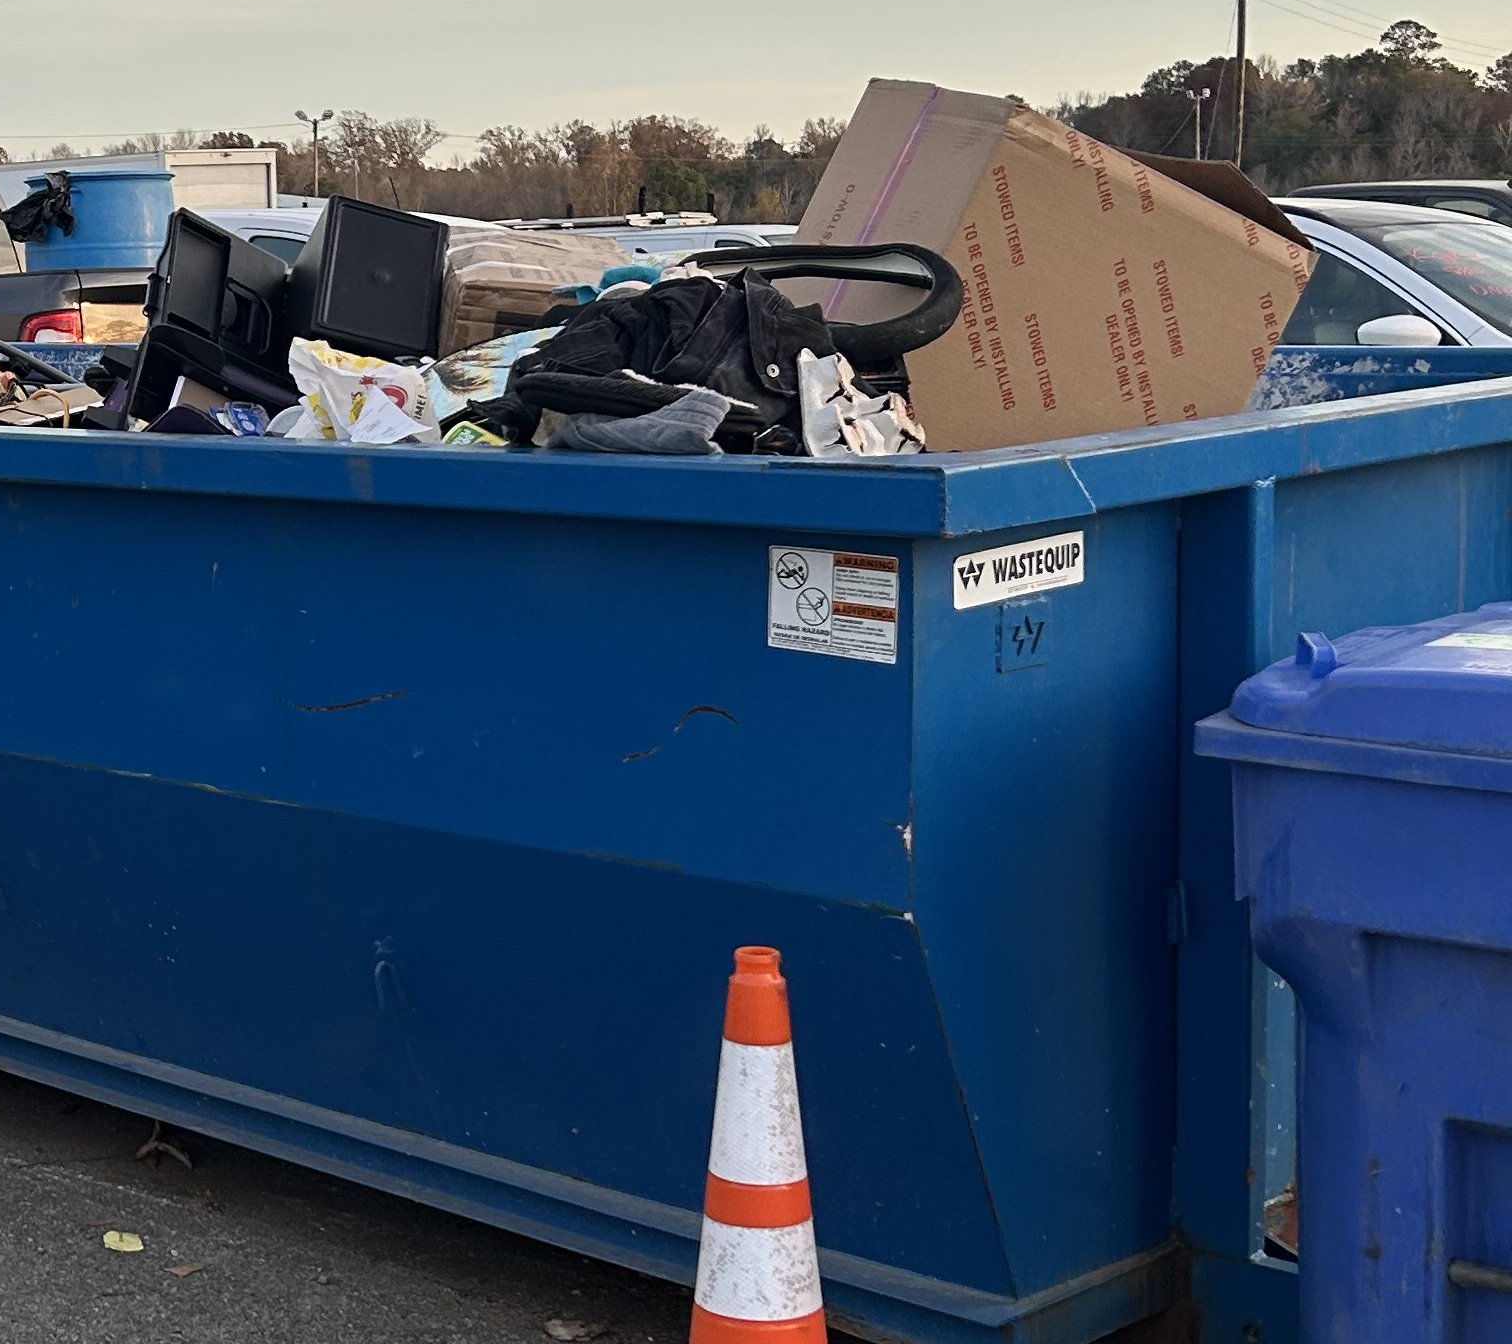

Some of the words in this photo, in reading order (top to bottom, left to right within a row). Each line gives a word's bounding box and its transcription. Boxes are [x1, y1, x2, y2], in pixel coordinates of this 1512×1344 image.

[1065, 130, 1086, 169] ONLY!
[1133, 169, 1155, 215] ITEMS!
[963, 221, 978, 242] TO
[992, 164, 1015, 222] STOWED
[1004, 222, 1026, 268] ITEMS!
[968, 243, 983, 262] BE
[1113, 258, 1128, 277] TO
[972, 263, 994, 314] OPENED
[1117, 278, 1132, 298] BE
[1259, 290, 1274, 310] TO
[984, 315, 999, 333] BY
[1121, 298, 1142, 349] OPENED
[1153, 259, 1175, 314] STOWED
[1164, 315, 1185, 359] ITEMS!
[1263, 312, 1278, 330] BE
[968, 331, 988, 371] ONLY!
[1024, 313, 1048, 367] STOWED
[1036, 368, 1057, 412] ITEMS!
[1105, 313, 1126, 364] DEALER
[1116, 365, 1136, 403] ONLY!
[1132, 350, 1147, 367] BY
[989, 337, 1016, 411] INSTALLING
[1137, 370, 1161, 427] INSTALLI
[843, 557, 895, 570] WARNING
[992, 542, 1080, 585] WASTEQUIP
